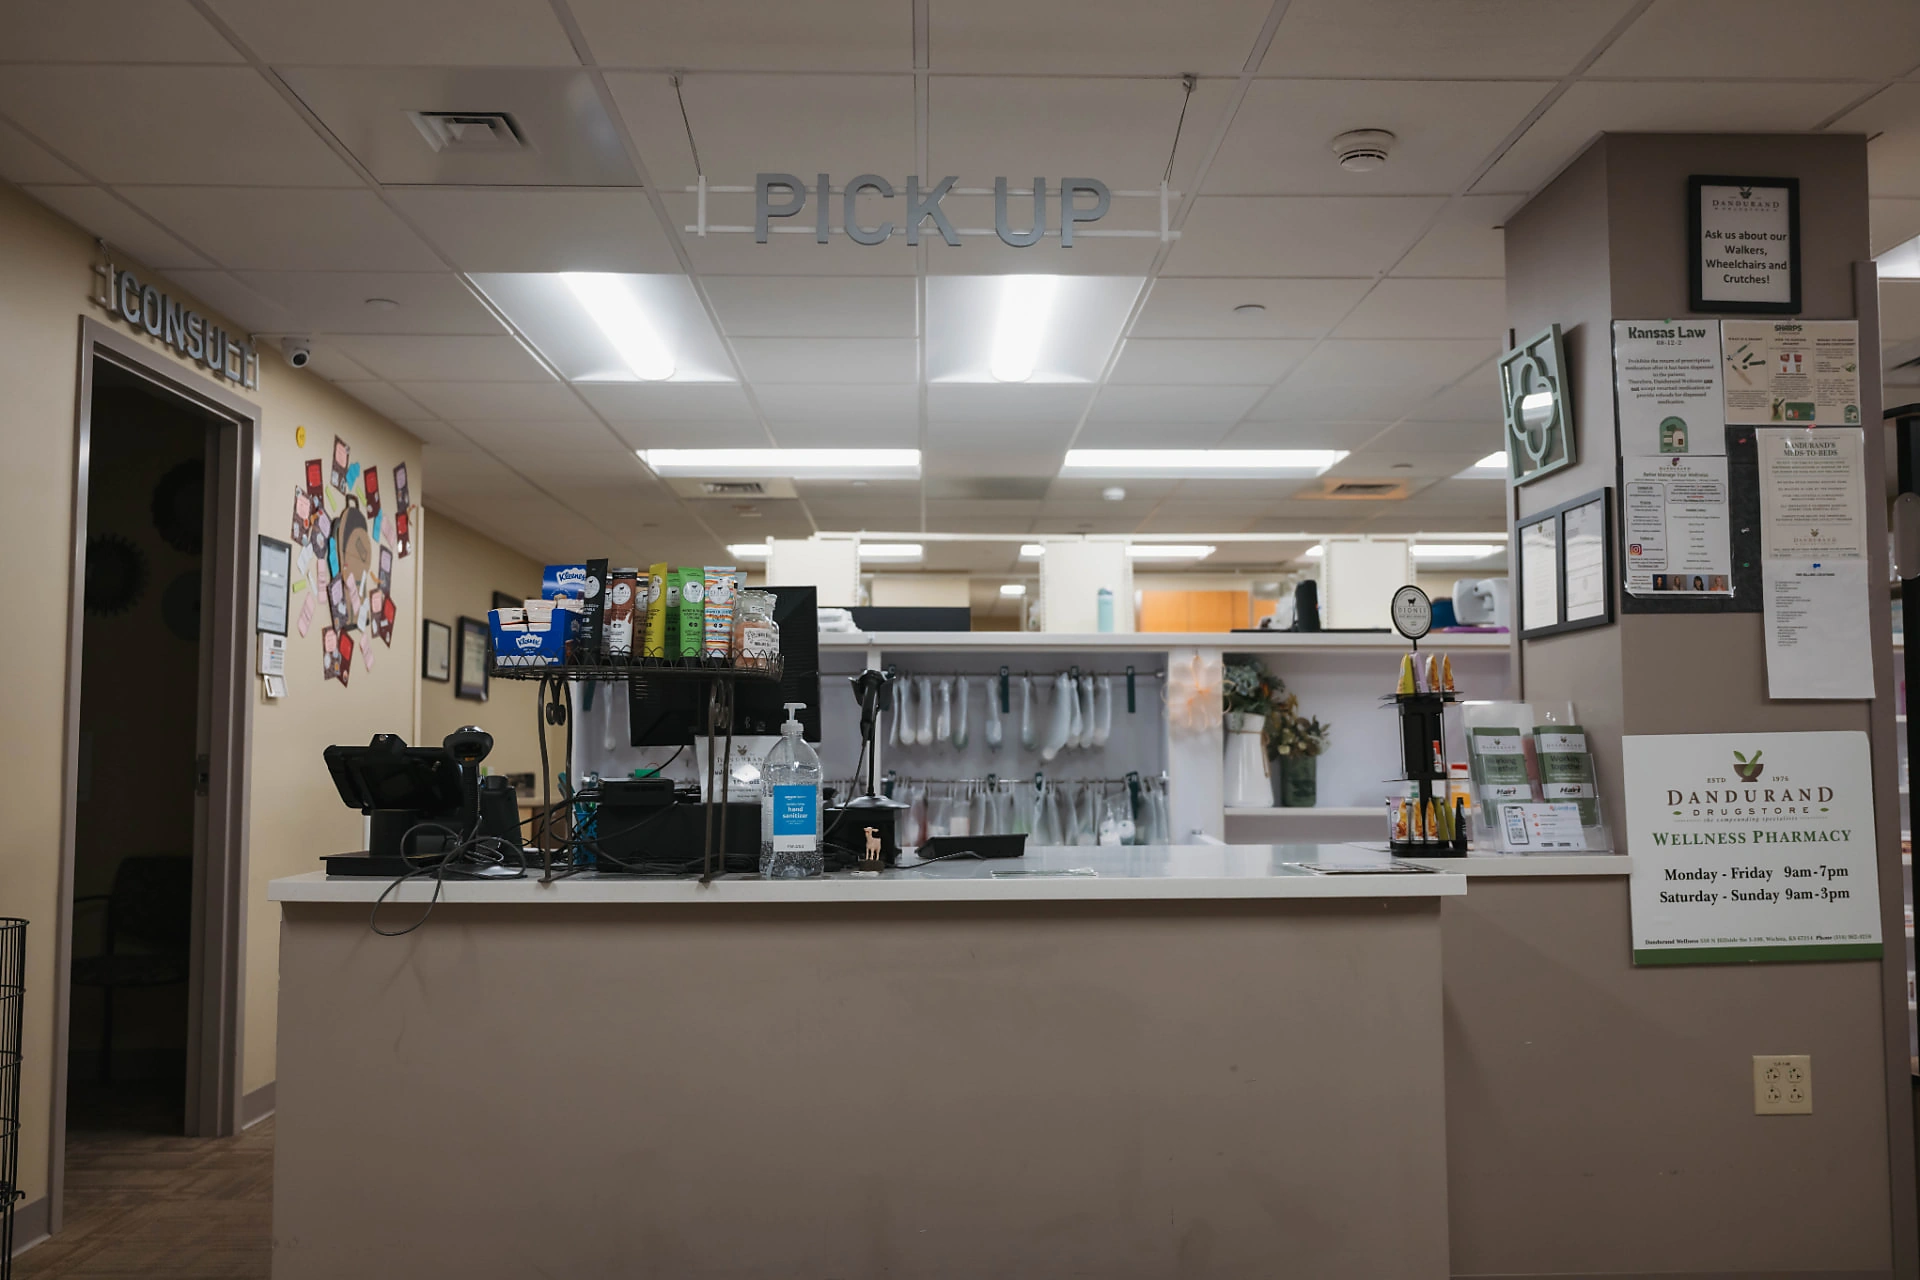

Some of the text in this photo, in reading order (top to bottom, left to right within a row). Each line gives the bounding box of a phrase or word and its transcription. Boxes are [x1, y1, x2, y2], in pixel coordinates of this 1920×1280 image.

[756, 173, 1112, 249] PICK UP
[1712, 200, 1780, 209] DANDURAND
[1705, 230, 1722, 240] Ask
[1725, 232, 1736, 240] us
[1738, 231, 1768, 240] about
[1724, 245, 1768, 256] Walkers,
[1705, 259, 1787, 270] Wheelchairs and
[1723, 274, 1770, 284] Crutches!
[117, 270, 253, 387] CONSULT
[1628, 326, 1706, 339] Kansas Law
[1667, 786, 1834, 807] DANDURAND
[1692, 806, 1809, 816] DRUGSTORE
[1652, 829, 1852, 847] WELLNESS PHARMACY
[1665, 867, 1719, 884] Monday
[1731, 866, 1774, 883] Friday
[1784, 864, 1849, 879] 9am-7pm
[1659, 890, 1719, 906] Saturday
[1731, 888, 1780, 905] Sunday
[1785, 887, 1850, 902] 9am-3pm
